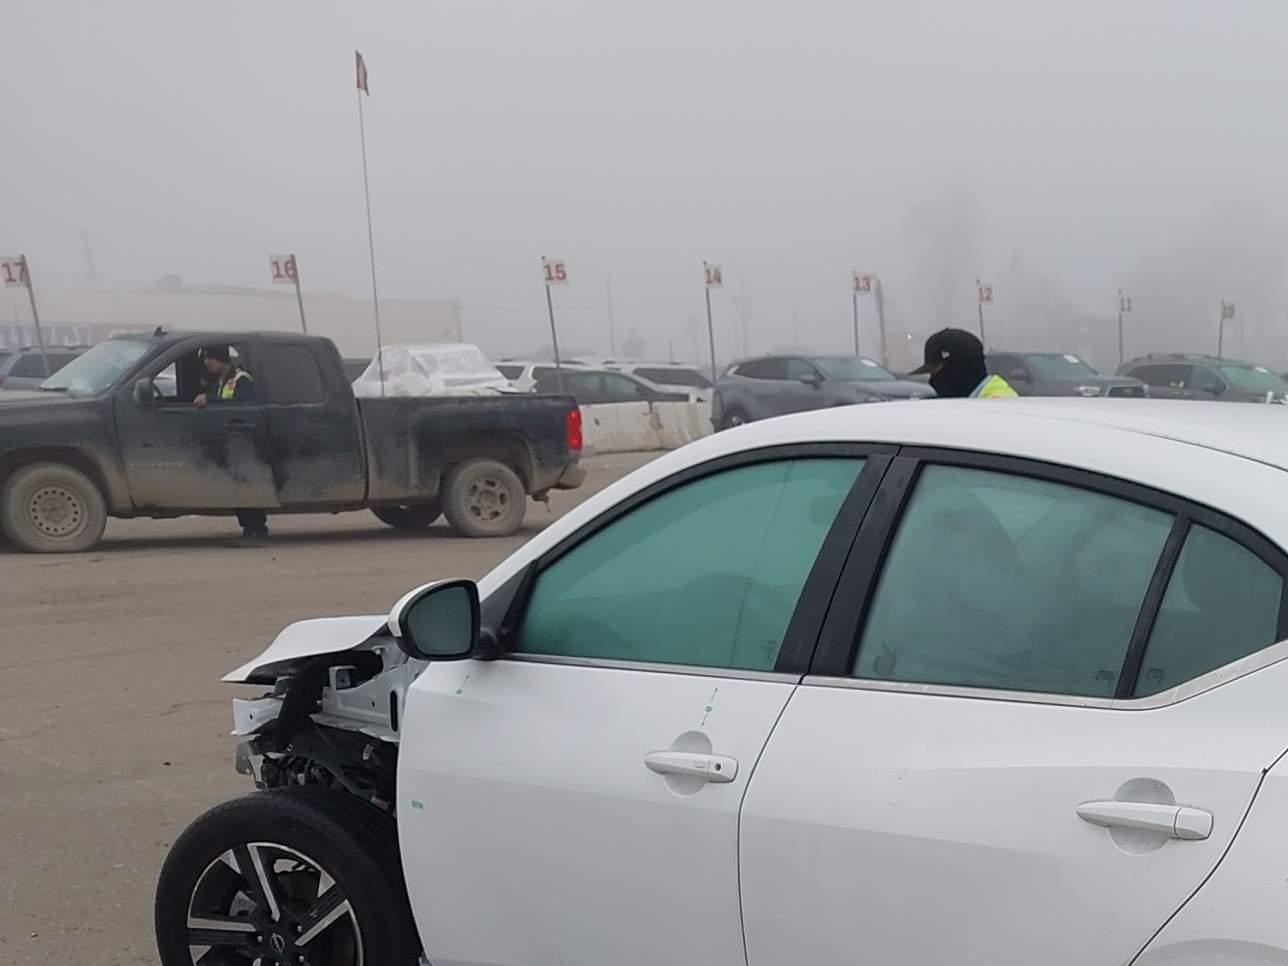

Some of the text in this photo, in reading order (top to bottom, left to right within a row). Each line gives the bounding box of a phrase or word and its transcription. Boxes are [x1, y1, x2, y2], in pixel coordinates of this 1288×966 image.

[2, 262, 27, 282] 17
[271, 260, 297, 279] 16
[544, 264, 567, 280] 15
[705, 269, 722, 284] 14
[854, 277, 871, 291] 13
[979, 287, 993, 301] 12
